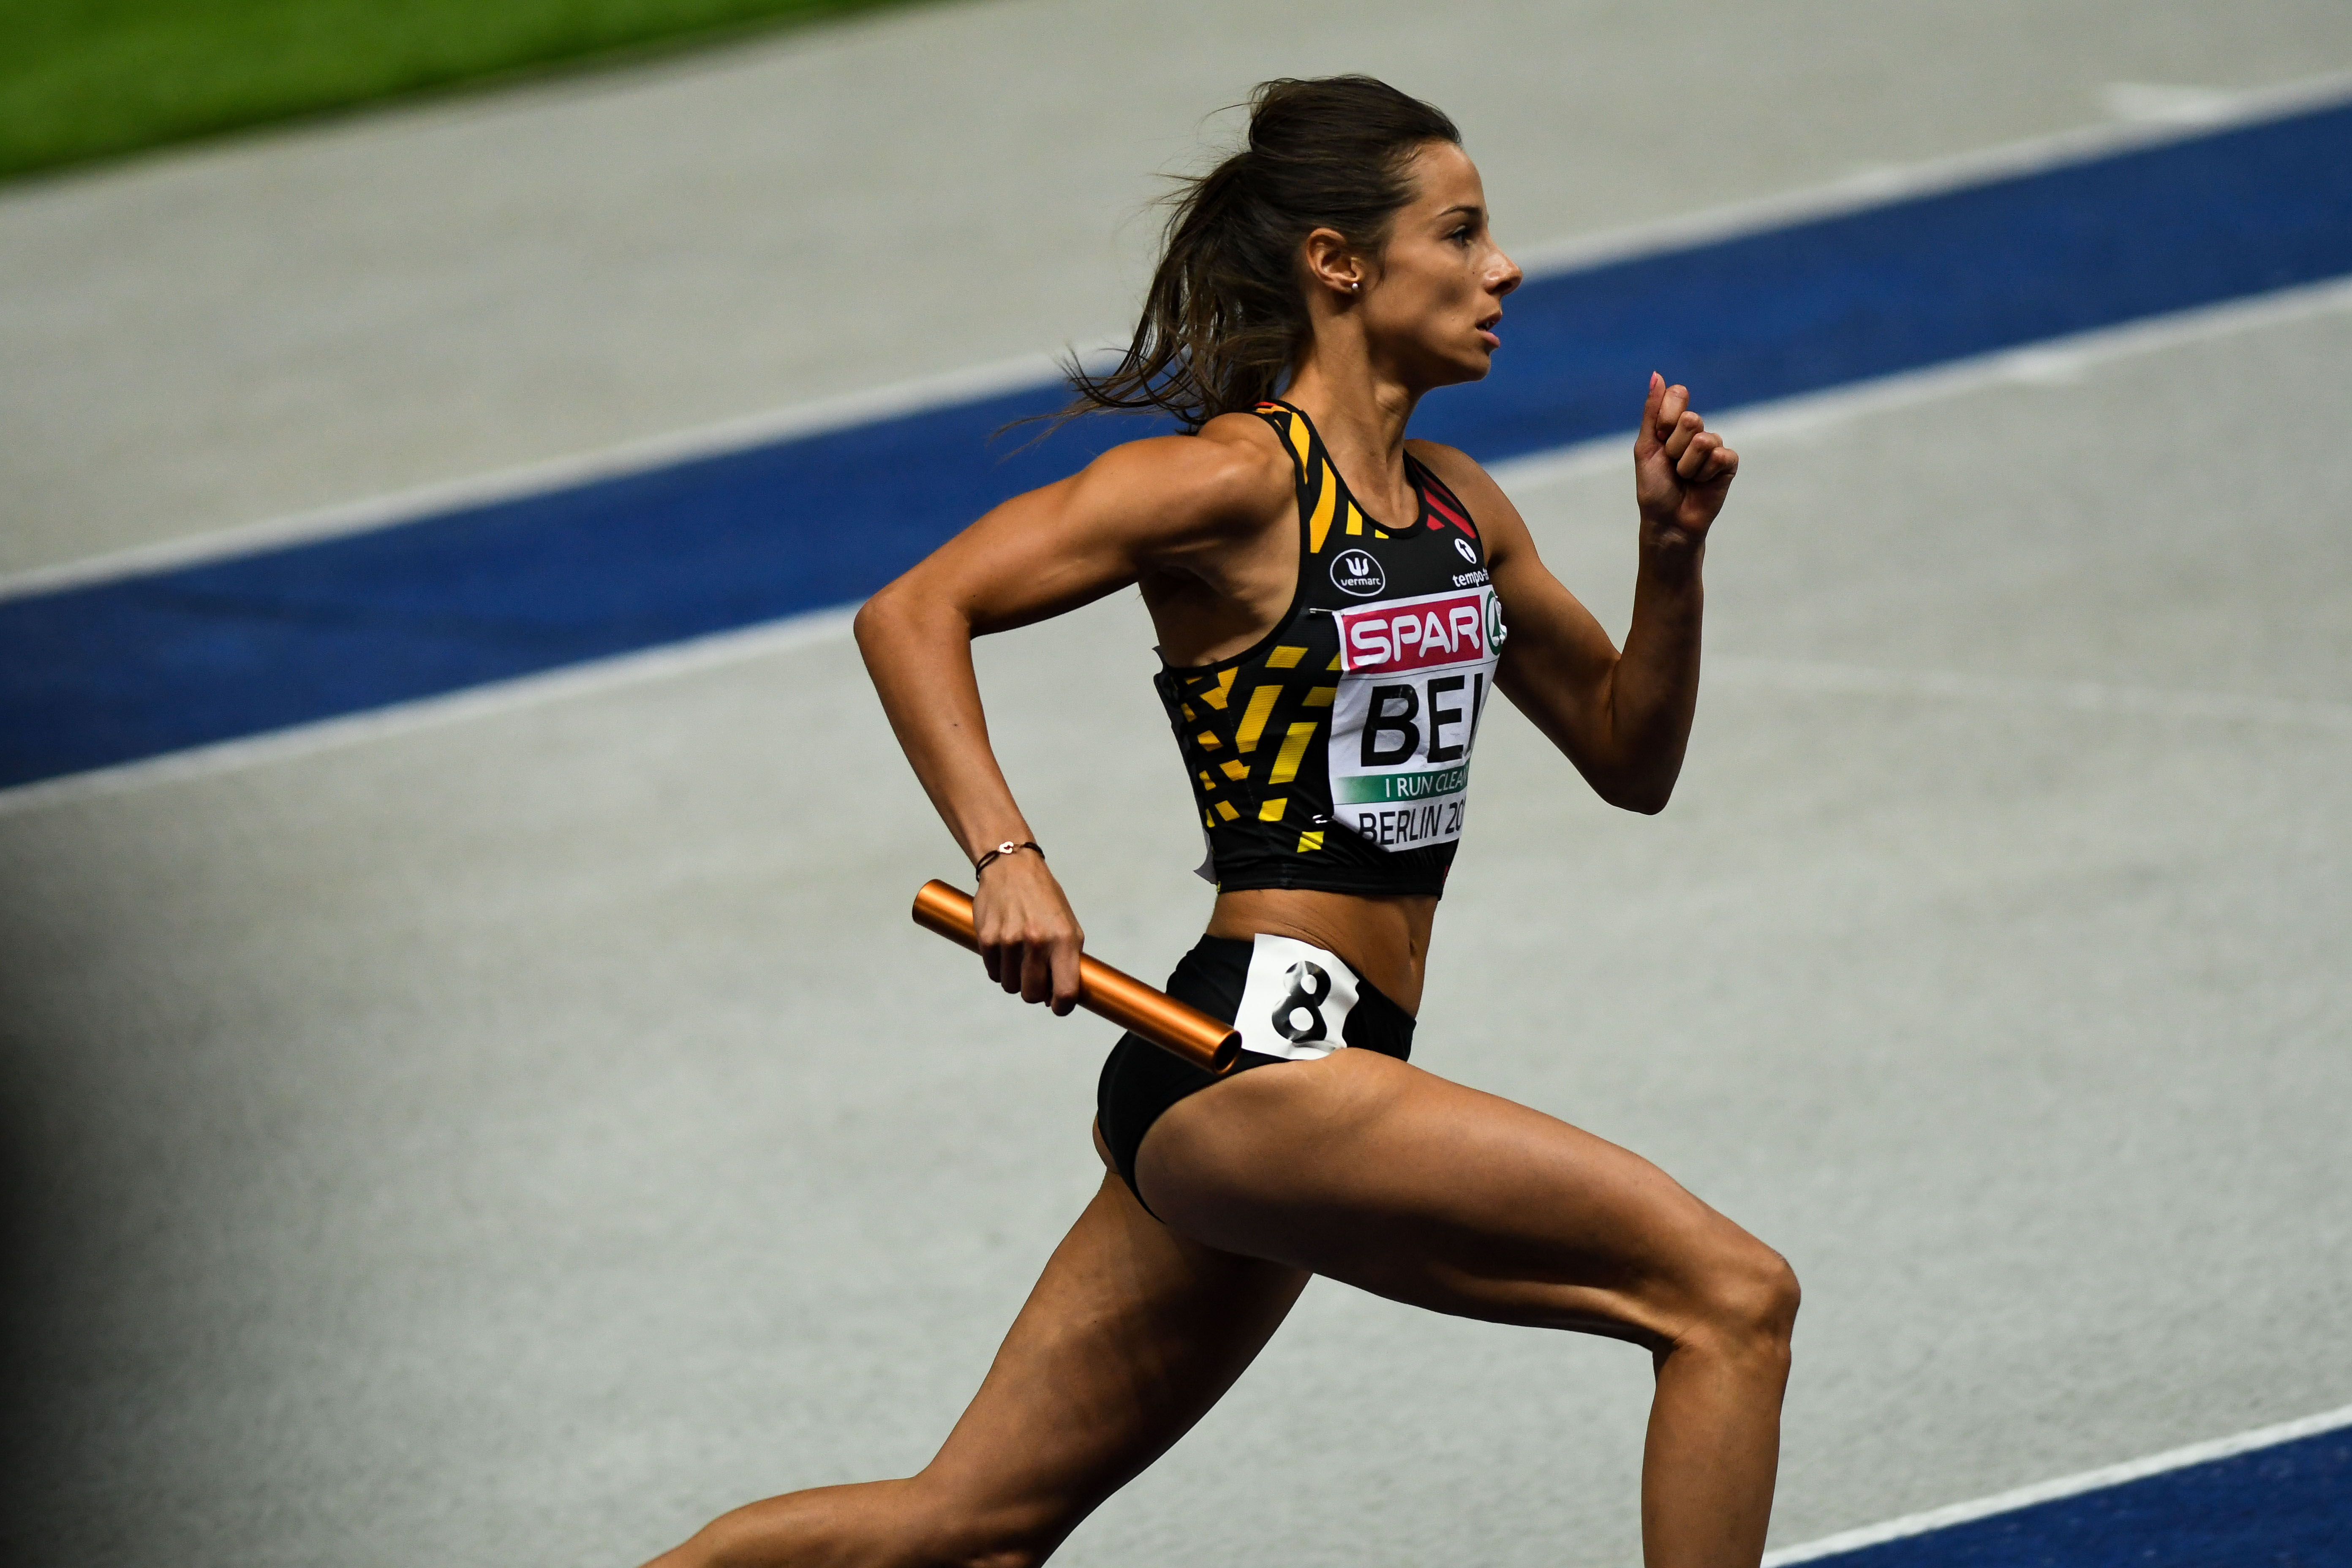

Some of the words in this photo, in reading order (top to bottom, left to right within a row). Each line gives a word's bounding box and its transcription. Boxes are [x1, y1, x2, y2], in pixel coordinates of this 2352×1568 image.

[1340, 578, 1381, 586] vermarc
[1351, 606, 1480, 666] SPAR
[1386, 778, 1390, 798] I
[1397, 776, 1433, 797] RUN
[1359, 804, 1442, 845] BERLIN
[1445, 796, 1466, 834] 20
[1271, 961, 1331, 1043] 8
